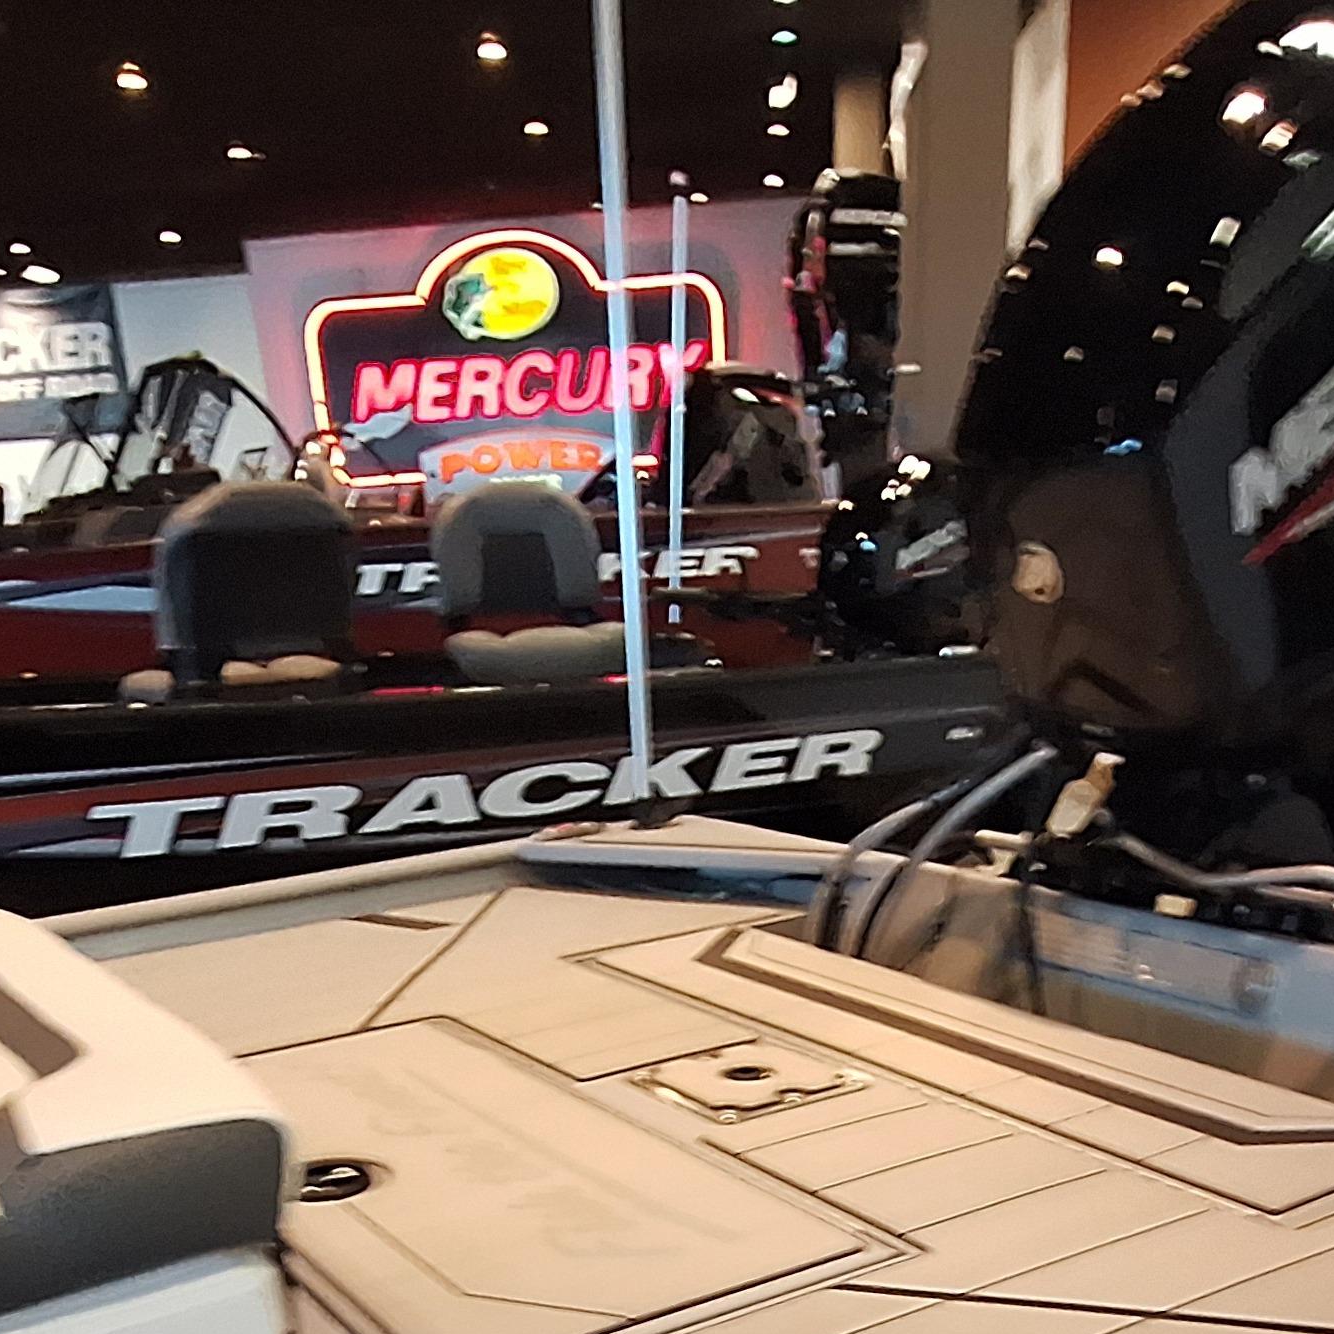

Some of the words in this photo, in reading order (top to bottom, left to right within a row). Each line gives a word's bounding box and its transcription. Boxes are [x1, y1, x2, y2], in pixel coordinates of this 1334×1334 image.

[353, 341, 709, 423] MERCURY
[440, 440, 604, 483] POWER
[86, 728, 884, 860] TRACKER
